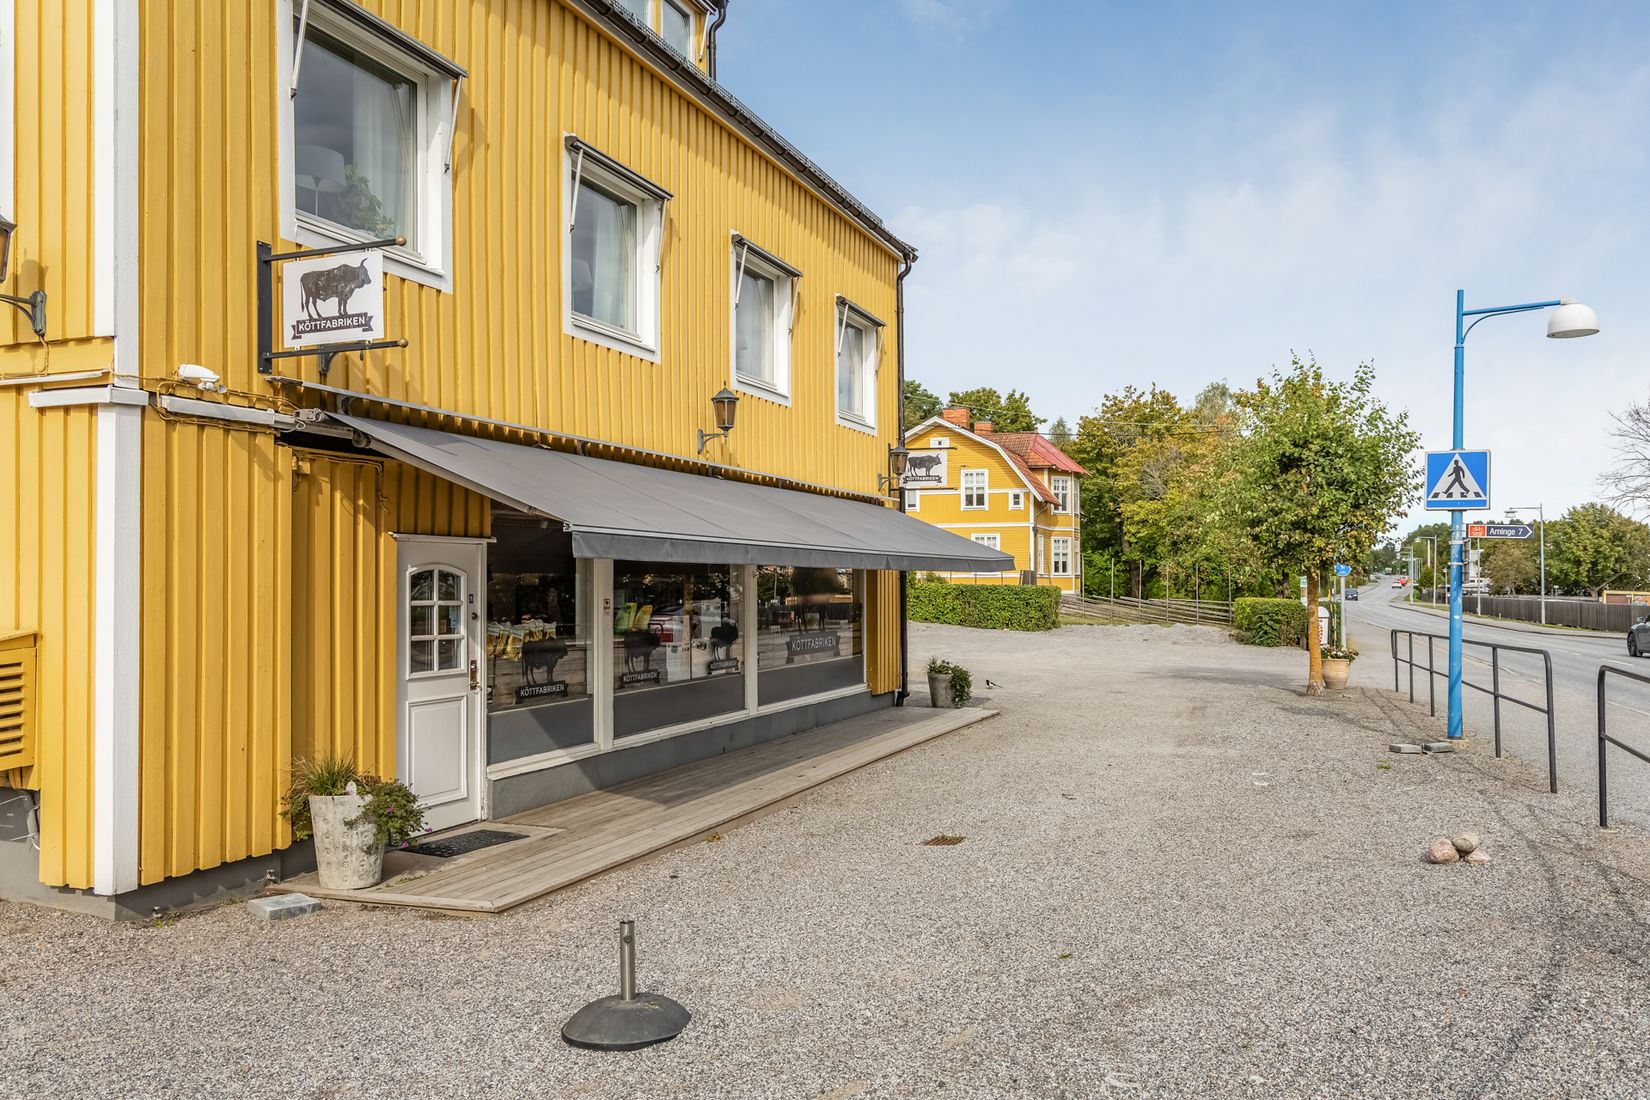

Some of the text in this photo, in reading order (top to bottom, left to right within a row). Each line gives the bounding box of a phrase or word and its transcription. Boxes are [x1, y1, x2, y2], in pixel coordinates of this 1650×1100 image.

[299, 316, 366, 332] KÖTTFABRIKEN
[1489, 527, 1516, 537] Arninge
[1518, 528, 1524, 536] 7
[791, 635, 836, 651] KÖTTFABRIKEN
[520, 683, 565, 697] KÖTTFABRIKEN
